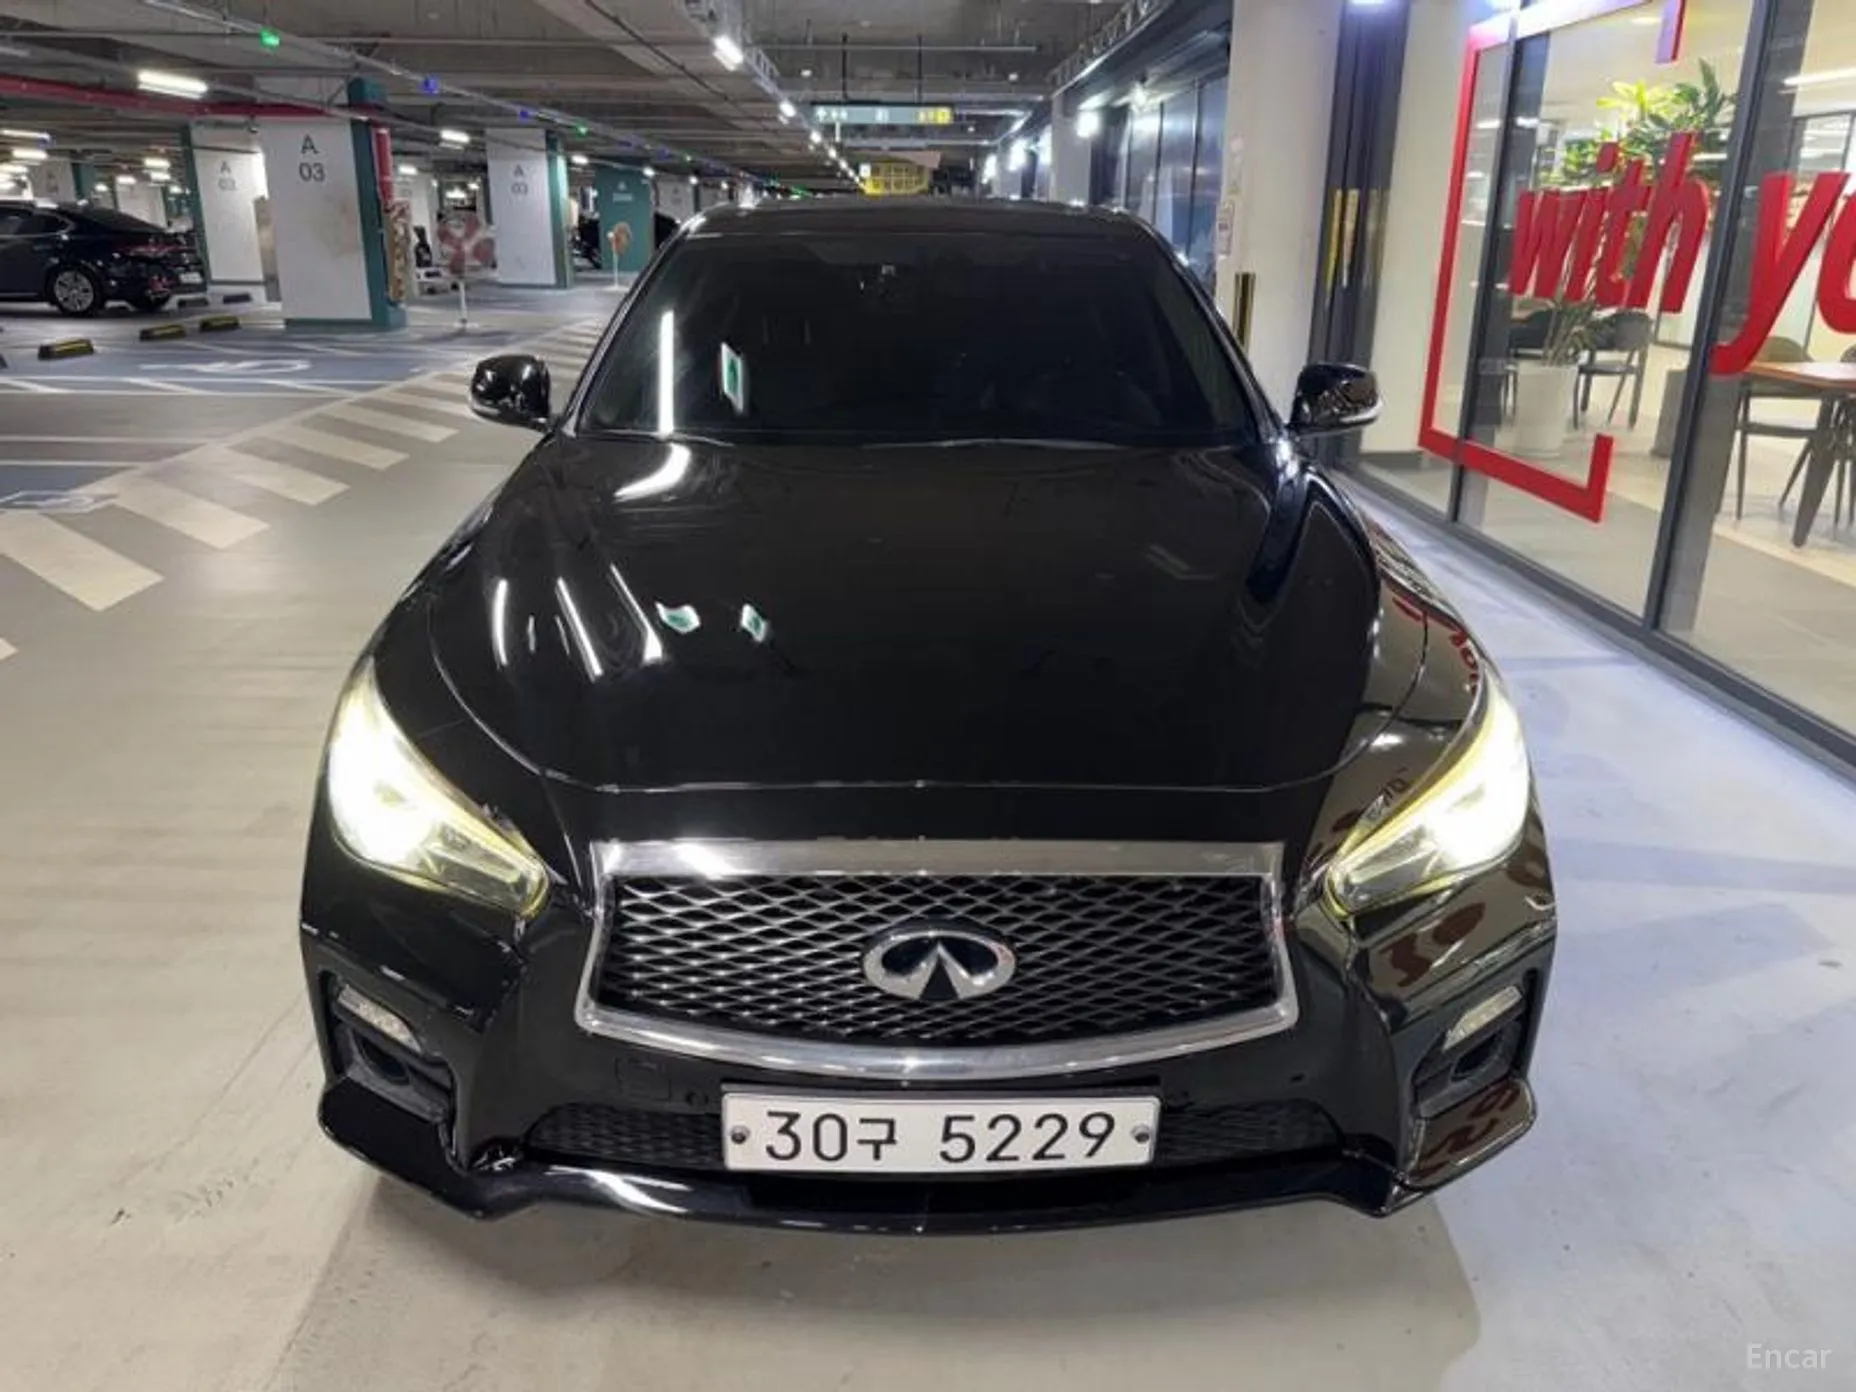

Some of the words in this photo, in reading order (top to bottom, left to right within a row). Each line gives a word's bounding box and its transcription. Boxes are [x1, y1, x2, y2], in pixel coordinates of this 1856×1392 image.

[300, 134, 320, 154] A
[299, 162, 325, 182] 03
[1510, 131, 1709, 313] with
[765, 1110, 896, 1162] 30구
[939, 1112, 1115, 1163] 5229
